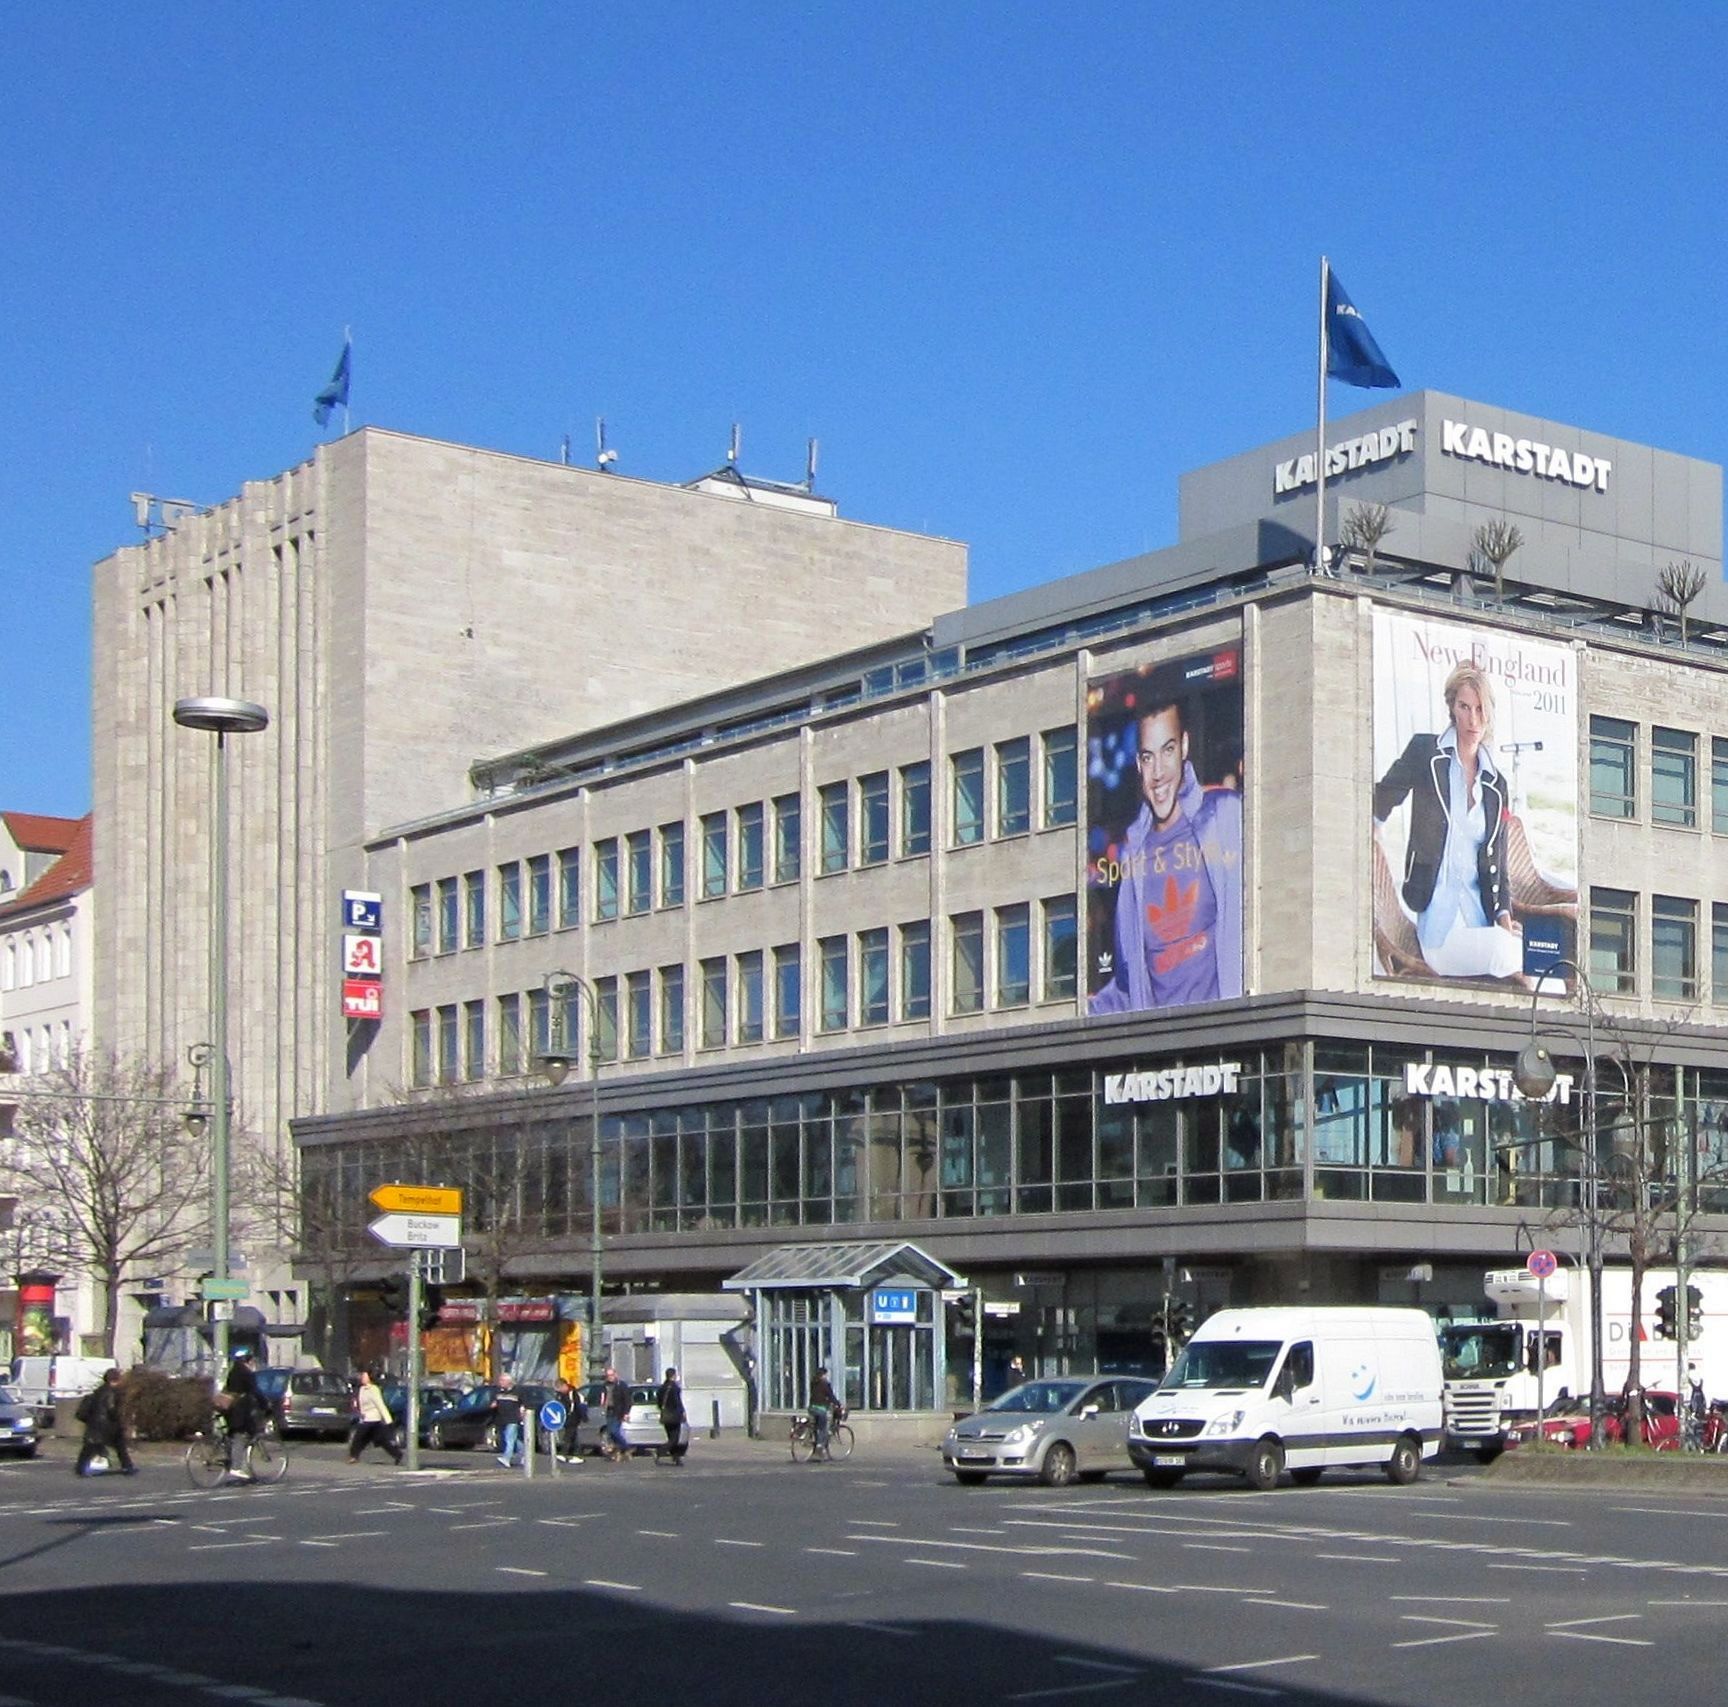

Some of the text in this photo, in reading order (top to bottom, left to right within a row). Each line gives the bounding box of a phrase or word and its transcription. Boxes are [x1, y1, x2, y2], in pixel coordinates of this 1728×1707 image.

[1275, 418, 1418, 494] KARSTADT
[1442, 418, 1612, 491] KARSTADT
[1413, 631, 1567, 689] New England
[1533, 689, 1566, 715] 2011
[1097, 852, 1147, 888] Sport
[1154, 846, 1167, 874] &
[352, 903, 366, 921] P
[1104, 1063, 1242, 1105] KARSTADT
[1405, 1062, 1574, 1105] KARSTT
[407, 1219, 439, 1229] Buckow
[407, 1231, 428, 1242] Britz
